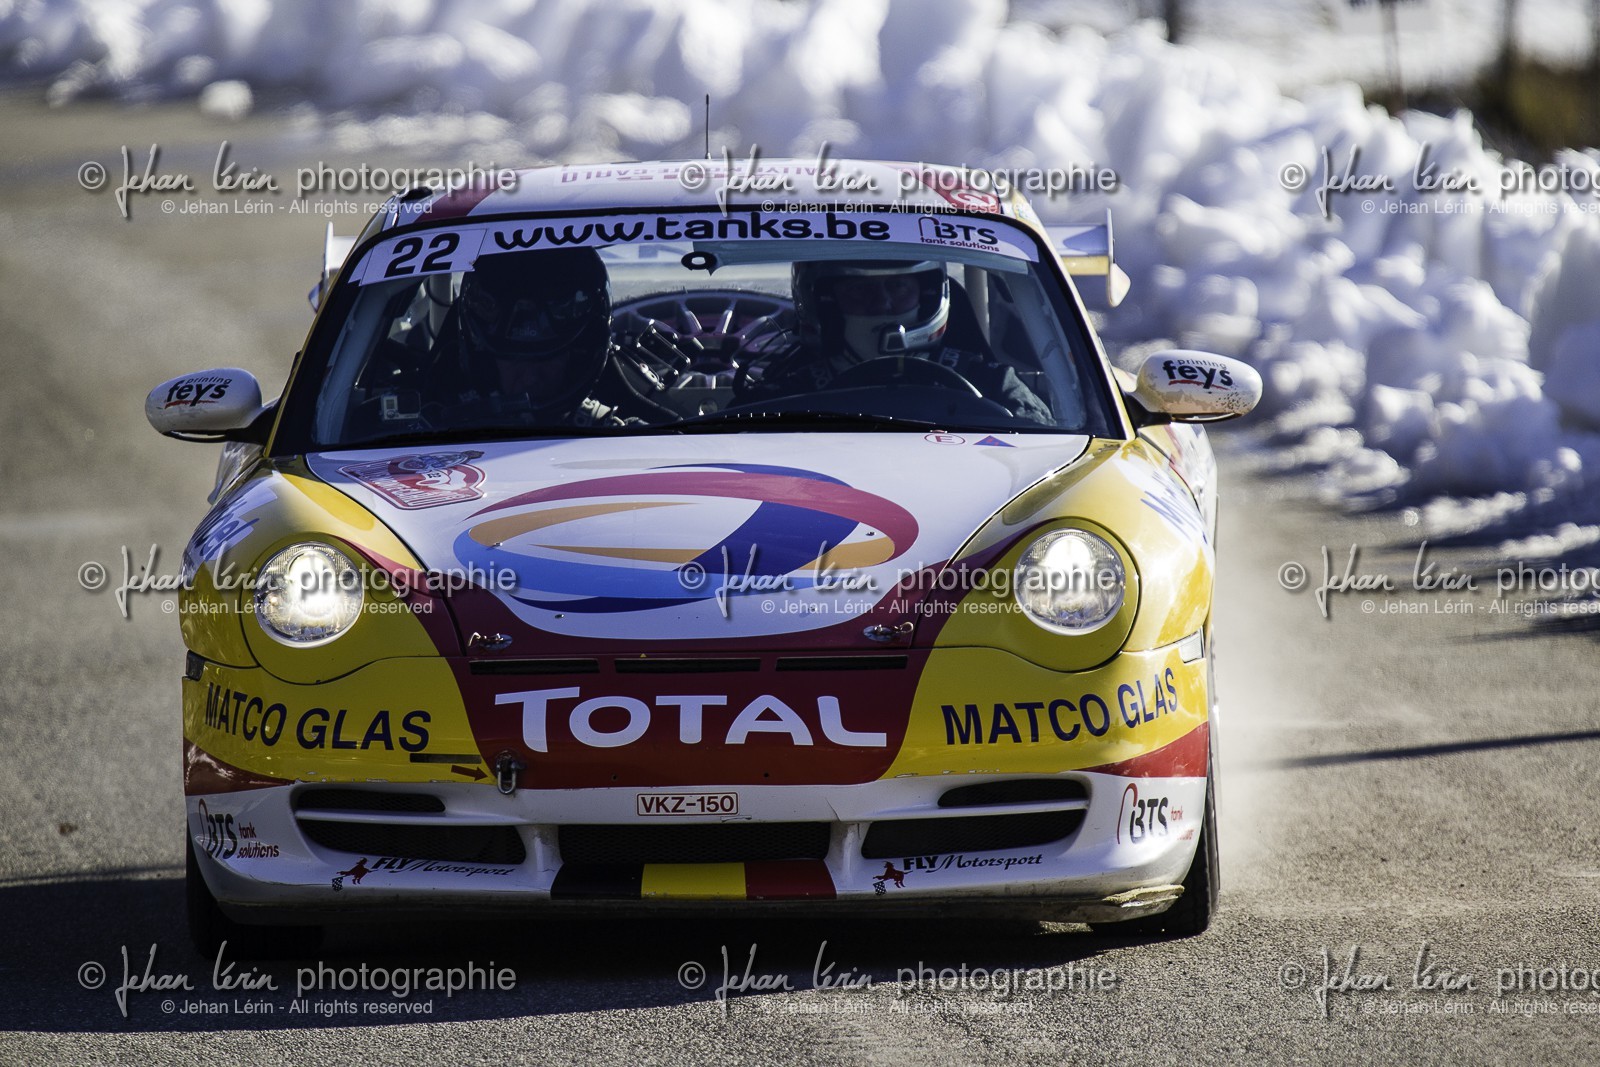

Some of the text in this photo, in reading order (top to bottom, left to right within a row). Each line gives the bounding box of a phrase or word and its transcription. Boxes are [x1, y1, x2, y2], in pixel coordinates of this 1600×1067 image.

[933, 221, 998, 245] BTS
[384, 211, 891, 278] 22 www.tanks.be
[920, 237, 1000, 252] tank solutions
[1162, 360, 1234, 389] feys
[1178, 358, 1227, 369] printing
[186, 376, 233, 385] printing
[166, 380, 229, 407] feys
[204, 682, 432, 752] MATCO GLAS
[940, 667, 1178, 745] MATCO GLAS
[494, 686, 887, 753] TOTAL
[641, 795, 735, 813] VKZ-150
[236, 842, 280, 859] solutions
[371, 857, 413, 870] FLY
[903, 853, 1043, 874] FLY Motorsport
